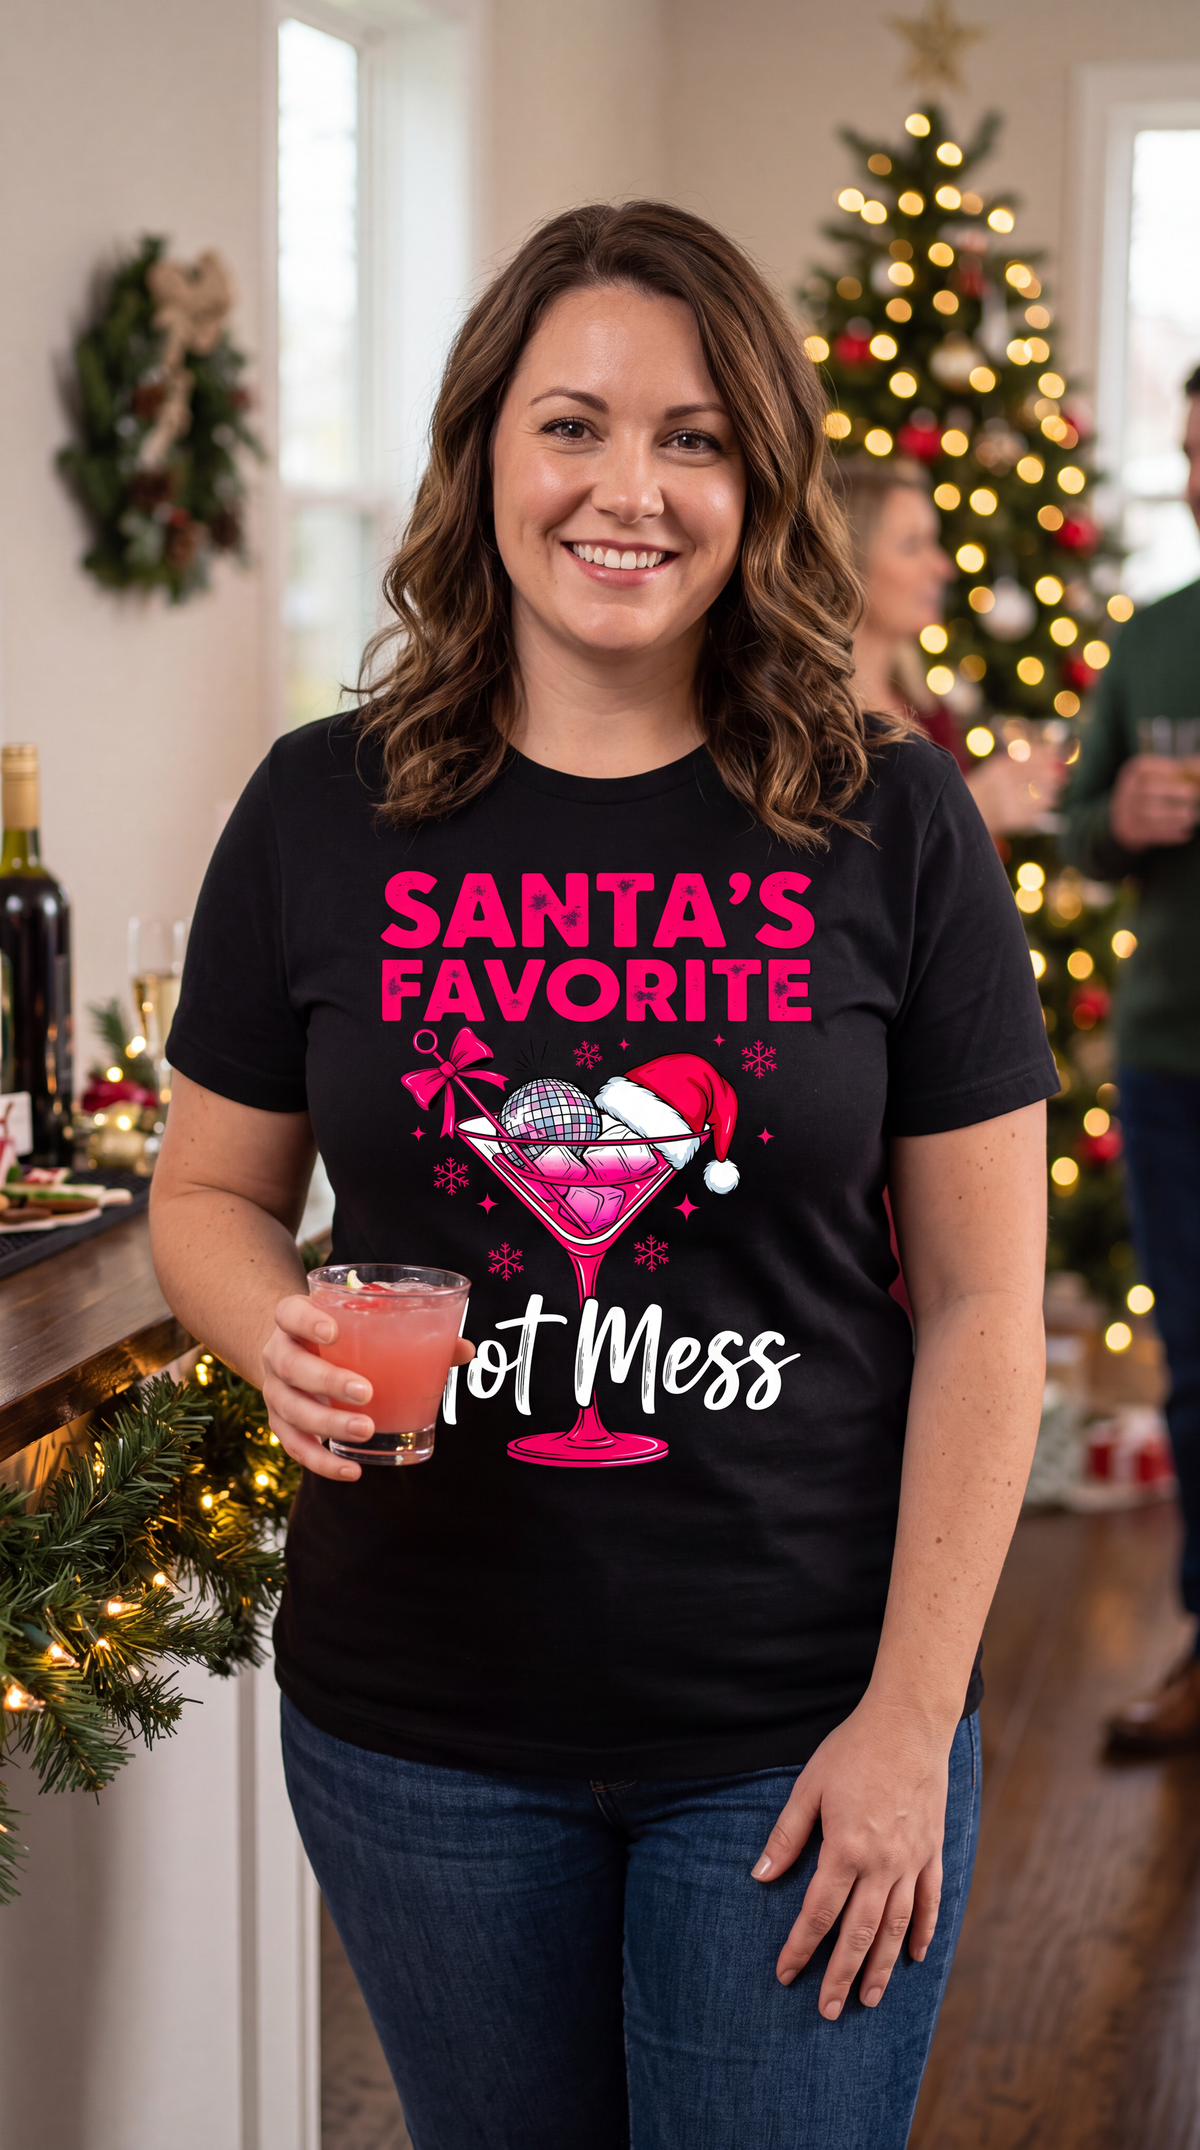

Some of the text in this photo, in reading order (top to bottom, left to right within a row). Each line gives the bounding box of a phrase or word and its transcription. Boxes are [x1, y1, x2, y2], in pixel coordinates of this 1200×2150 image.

[380, 870, 815, 949] SANTA’S
[381, 958, 812, 1023] FAVORITE
[574, 1298, 801, 1415] Mess
